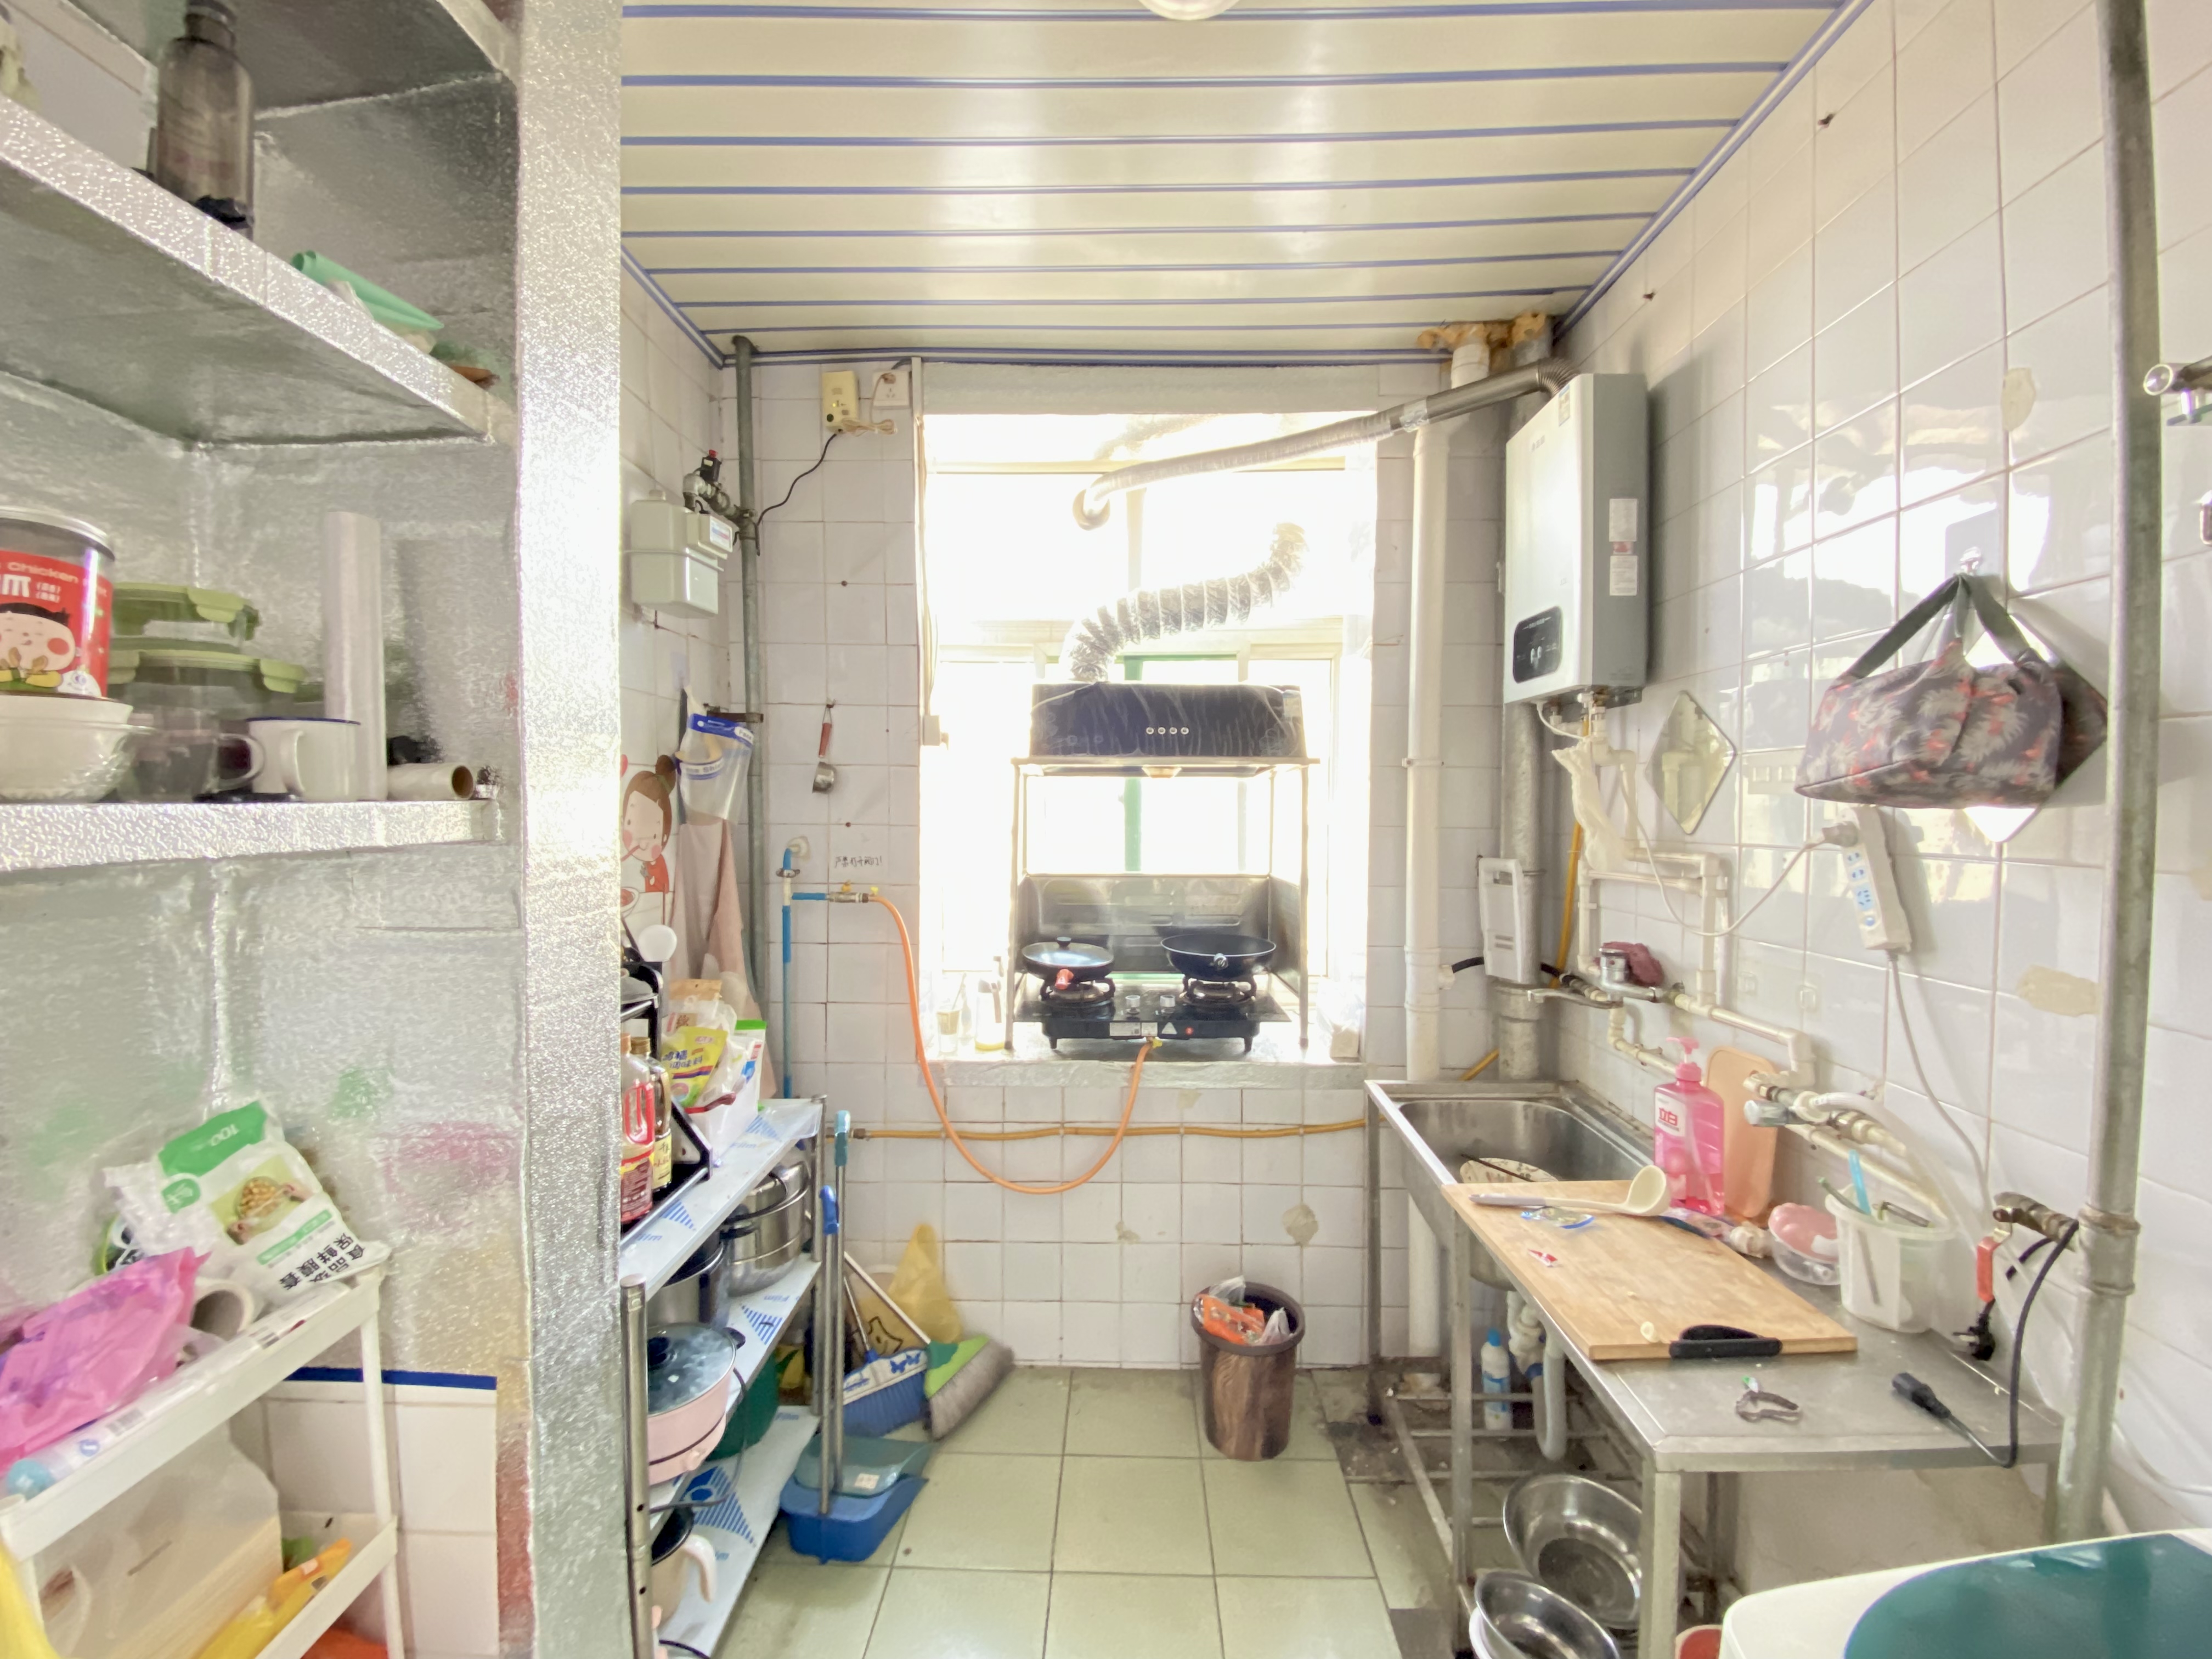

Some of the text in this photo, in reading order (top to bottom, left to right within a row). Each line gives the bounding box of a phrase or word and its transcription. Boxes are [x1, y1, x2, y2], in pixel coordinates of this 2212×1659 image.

[1658, 1107, 1678, 1126] 立白
[210, 1124, 239, 1147] 100
[279, 1233, 354, 1290] 保鲜膜套
